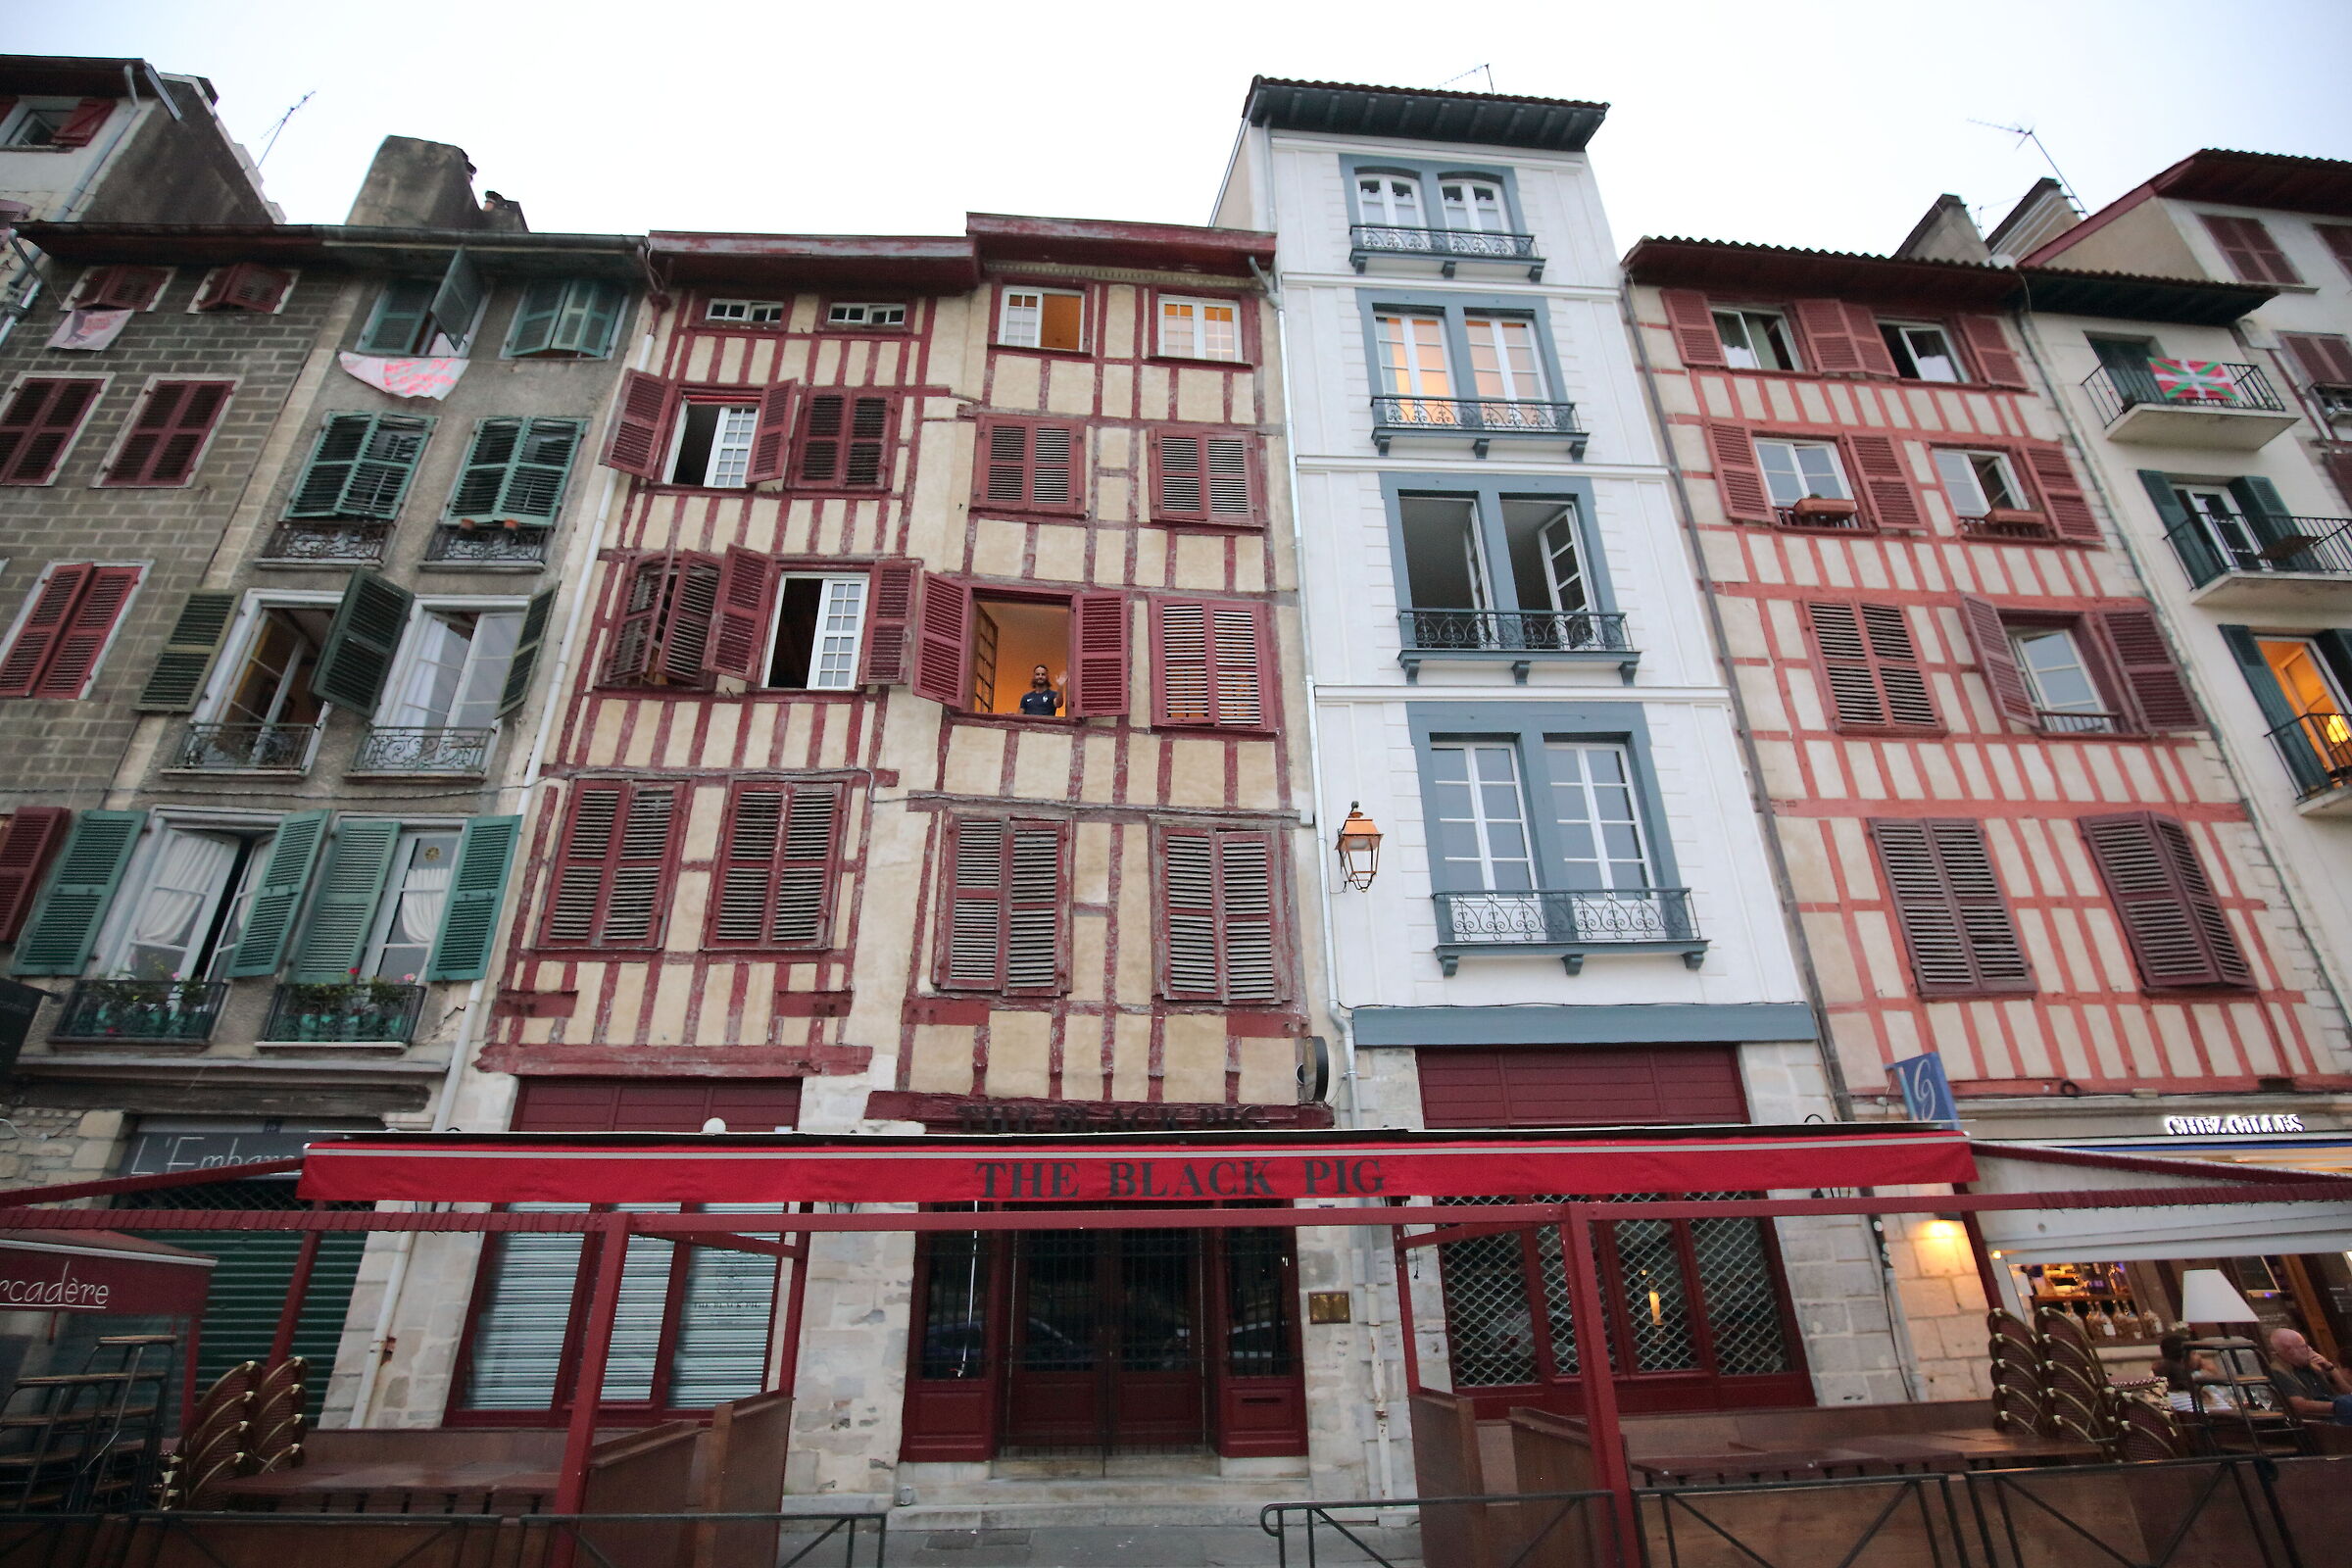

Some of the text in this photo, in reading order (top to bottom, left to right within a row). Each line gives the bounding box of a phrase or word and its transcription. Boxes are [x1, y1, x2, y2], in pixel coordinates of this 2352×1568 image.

[975, 1158, 1386, 1199] THE BLACK PIG
